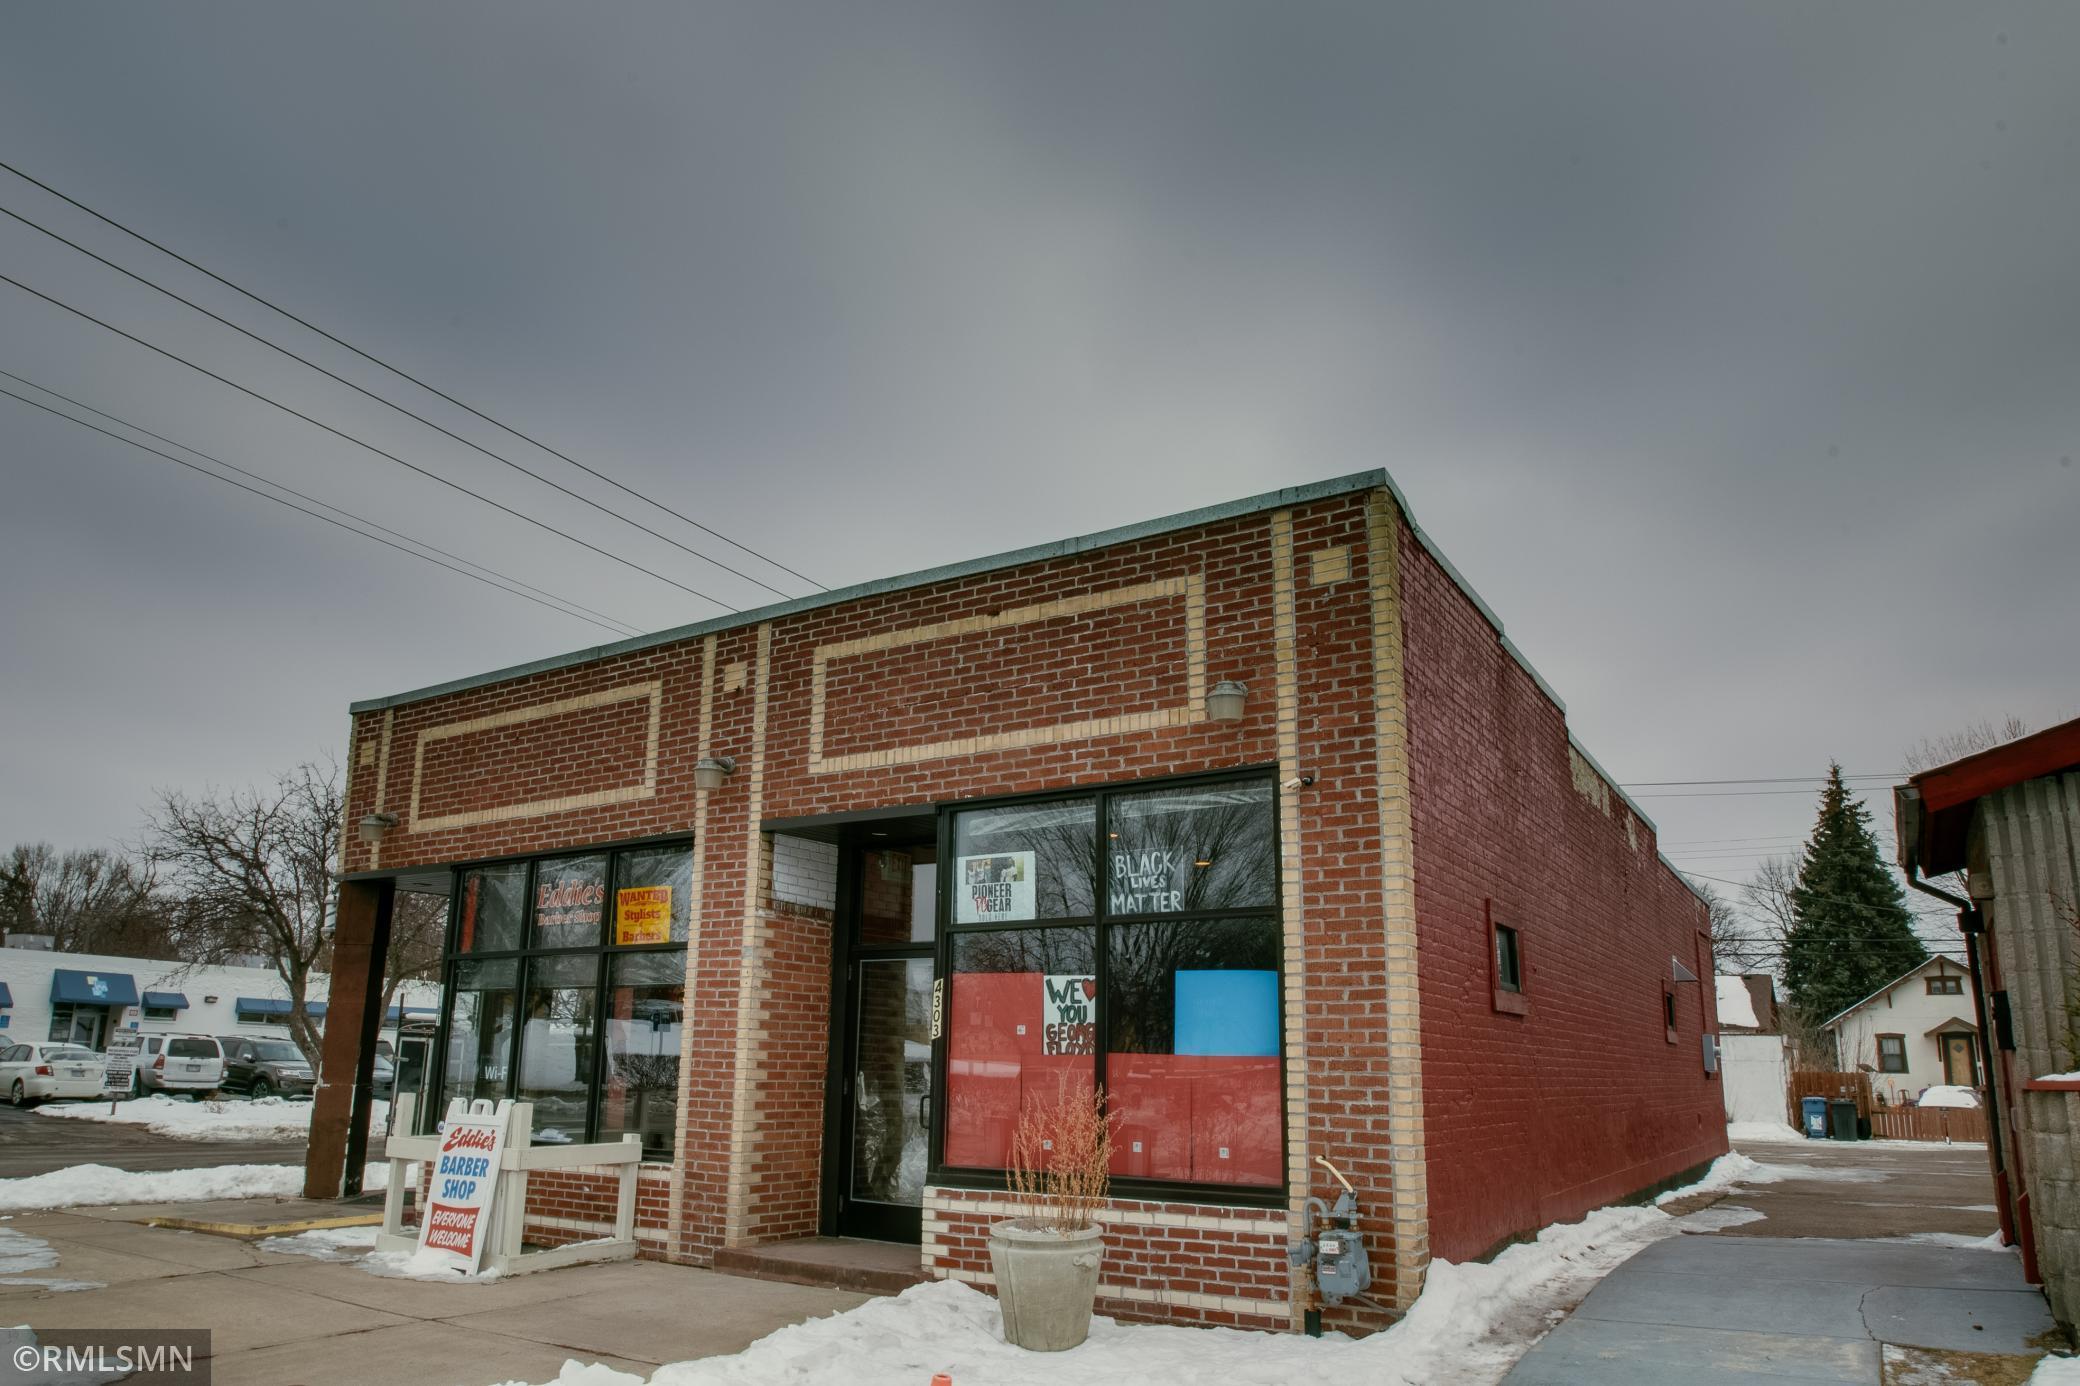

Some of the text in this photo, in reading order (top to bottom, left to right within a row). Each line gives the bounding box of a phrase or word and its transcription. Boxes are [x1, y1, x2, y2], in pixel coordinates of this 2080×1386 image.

[1115, 851, 1176, 878] BLACK
[972, 882, 1012, 899] PIONEER
[1130, 874, 1166, 889] LIVES
[536, 879, 605, 909] Eddie's
[619, 889, 669, 906] WANTED
[1111, 890, 1183, 915] MATTER
[624, 908, 661, 922] Stylists
[987, 898, 1011, 913] GEAR
[537, 909, 601, 926] Barber Shop
[623, 930, 661, 942] Barbers
[1045, 976, 1082, 1005] WE
[933, 981, 943, 1037] 4303
[1057, 1003, 1087, 1025] YOU
[442, 1126, 496, 1152] Eddie's
[440, 1155, 490, 1178] BARBER
[442, 1178, 476, 1200] SHOP
[431, 1210, 477, 1230] EVERYONE
[428, 1228, 471, 1249] WELCOME
